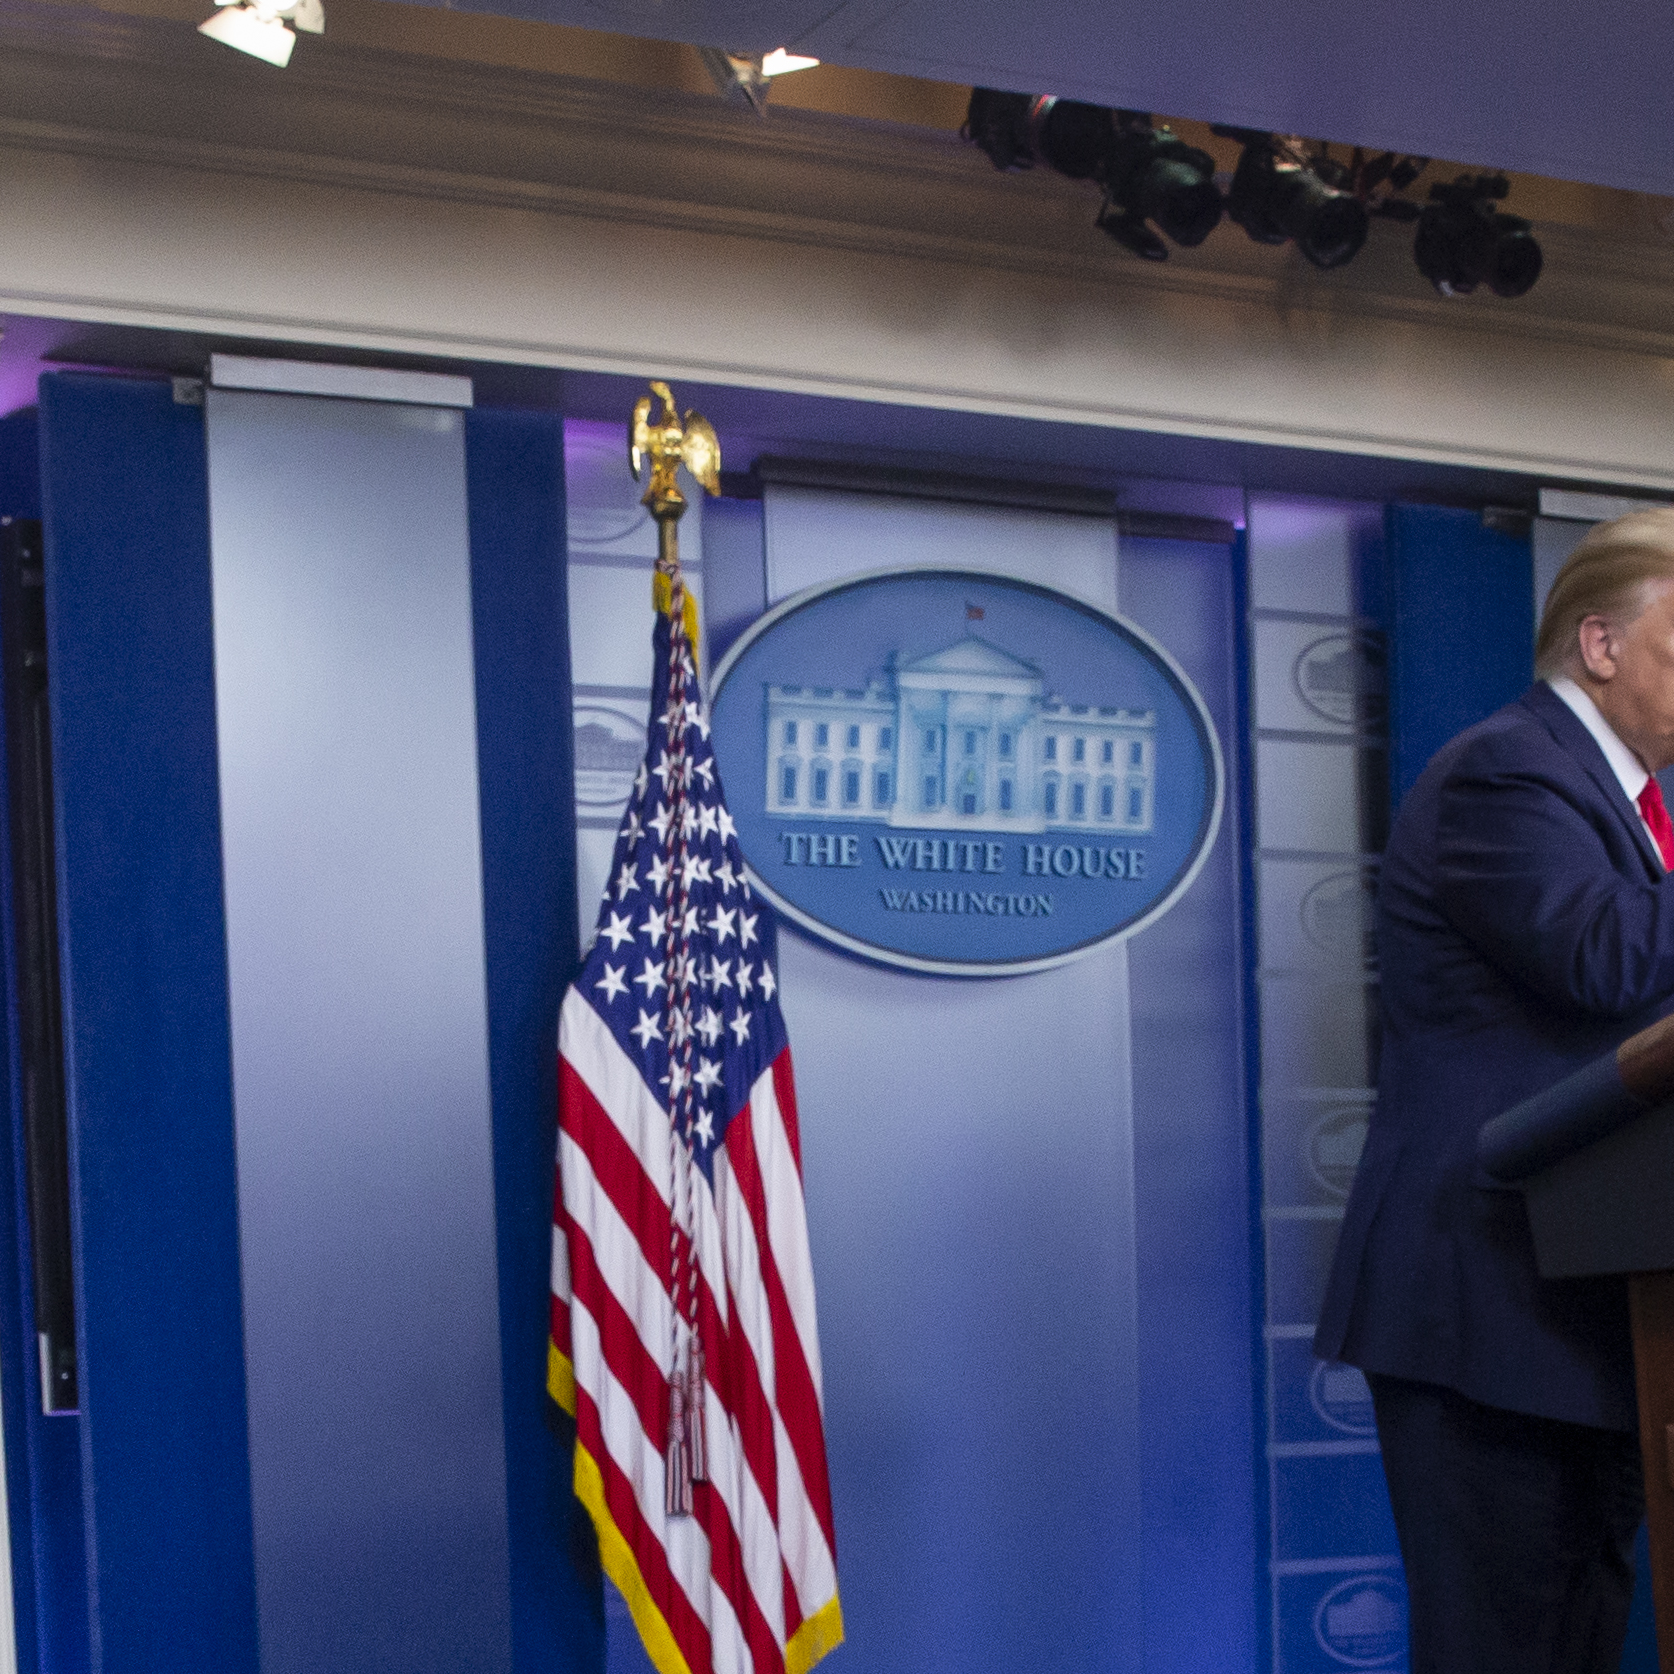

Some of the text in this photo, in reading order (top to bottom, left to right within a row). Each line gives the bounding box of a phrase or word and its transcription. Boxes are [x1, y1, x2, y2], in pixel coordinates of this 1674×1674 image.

[780, 832, 1147, 881] THE WHITE HOUSE
[879, 889, 1055, 917] WASHINGTON
